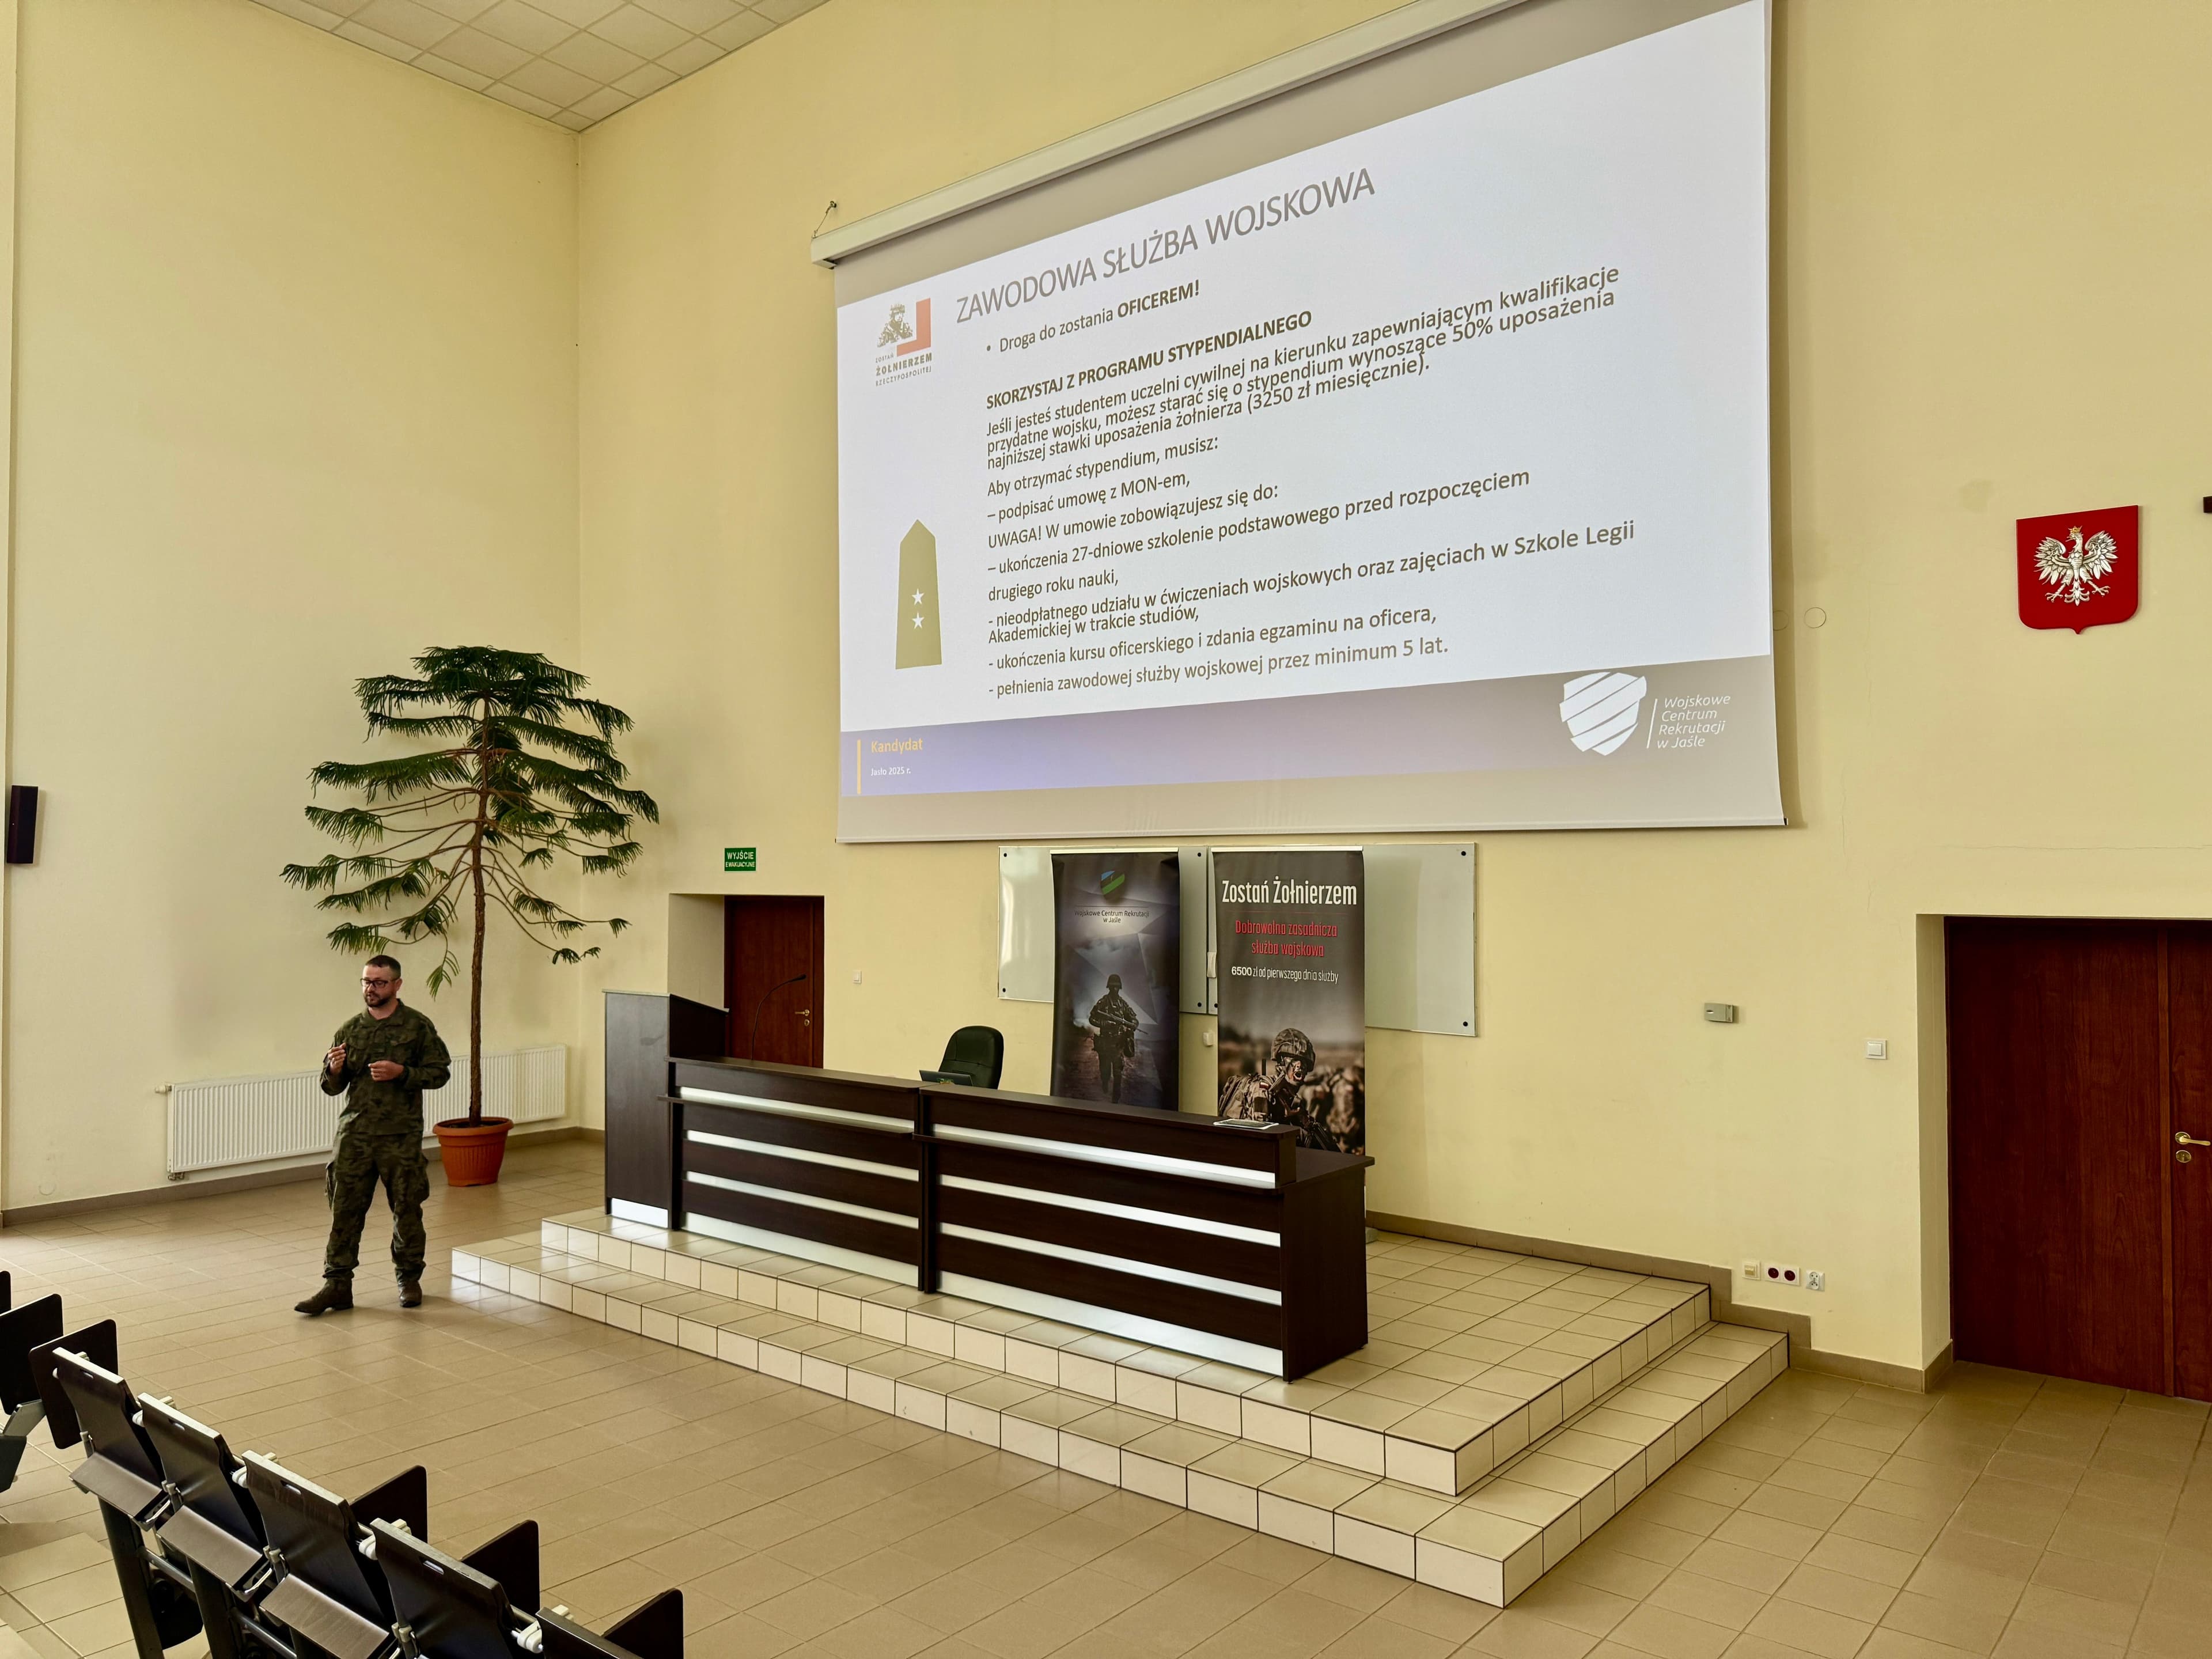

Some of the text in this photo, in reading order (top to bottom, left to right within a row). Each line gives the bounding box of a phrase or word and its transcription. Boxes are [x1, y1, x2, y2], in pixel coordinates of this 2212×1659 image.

[956, 168, 1376, 324] ZAWODOWA SŁUŻBA WOJSKOWA
[999, 279, 1199, 353] Droga do zostania OFICEREM!
[876, 353, 894, 363] ZOSTAŃ
[876, 353, 932, 376] ŻOŁNIERZEM
[986, 266, 1619, 437] Jeśli jesteś studentem uczelni cywilnej na kierunku zapewniającym kwalifikacje
[986, 310, 1312, 410] SKORZYSTAJ Z PROGRAMU STYPENDIALNEGO
[876, 366, 931, 387] RZECZYPOSPOLITEJ
[987, 292, 1614, 457] przydatne wojsku, możesz starać się o stypendium wynoszące 50% uposażenia
[987, 353, 1429, 471] najniższej stawki uposażenia żołnierza (3250 zł miesięcznie).
[987, 436, 1218, 497] Aby otrzymać stypendium, musisz:
[998, 494, 1054, 525] podpisać
[1058, 489, 1107, 509] umowę
[1110, 486, 1118, 500] z
[1120, 474, 1190, 498] MON-em,
[988, 483, 1278, 549] UWAGA! W umowie zobowiązujesz się do:
[999, 549, 1068, 574] ukończenia
[1071, 539, 1143, 563] 27-dniowe
[1147, 525, 1214, 550] szkolenie
[1218, 506, 1340, 543] podstawowego
[1345, 490, 1393, 521] przed
[1399, 471, 1529, 507] rozpoczęciem
[988, 568, 1119, 603] drugiego roku nauki,
[997, 604, 1088, 627] nieodpłatnego
[1092, 594, 1140, 615] udziału
[1143, 594, 1157, 608] w
[1160, 577, 1249, 605] ćwiczeniach
[1253, 562, 1352, 593] wojskowych
[1357, 560, 1395, 578] oraz
[1399, 542, 1485, 574] zajęciach
[1490, 543, 1509, 558] w
[1514, 529, 1578, 555] Szkole
[1586, 520, 1634, 546] Legii
[988, 603, 1199, 644] Akademickiej w trakcie studiów,
[997, 648, 1066, 669] ukończenia
[1070, 646, 1105, 662] kursu
[1109, 636, 1194, 658] oficerskiego
[1198, 631, 1202, 648] i
[1206, 626, 1255, 647] zdania
[1259, 618, 1338, 644] egzaminu
[1343, 616, 1363, 632] na
[1369, 608, 1437, 628] oficera,
[997, 677, 1054, 700] pełnienia
[1057, 668, 1132, 691] zawodowej
[1136, 664, 1181, 684] służby
[1184, 654, 1263, 680] wojskowej
[1268, 654, 1310, 675] przez
[1315, 645, 1397, 666] minimum
[1403, 639, 1414, 657] 5
[1419, 637, 1448, 655] lat.
[1662, 710, 1717, 721] Centrum
[1664, 695, 1730, 710] Wojskowe
[1657, 736, 1706, 749] w Jaśle
[1658, 721, 1726, 736] Rekrutacji
[871, 737, 923, 754] Kandydat
[871, 767, 887, 776] Jasło
[889, 766, 905, 775] 2025
[727, 850, 754, 859] WYJŚCIE
[1222, 876, 1357, 905] Zostań Żołnierzem
[1074, 910, 1100, 918] Wojskowe
[1124, 910, 1149, 918] Rekrutacji
[1235, 919, 1338, 937] Dobrowolna zasadnicza
[1251, 940, 1324, 959] służba wojskowa
[1231, 967, 1339, 984] 6500 zł od pierwszego dnia służby
